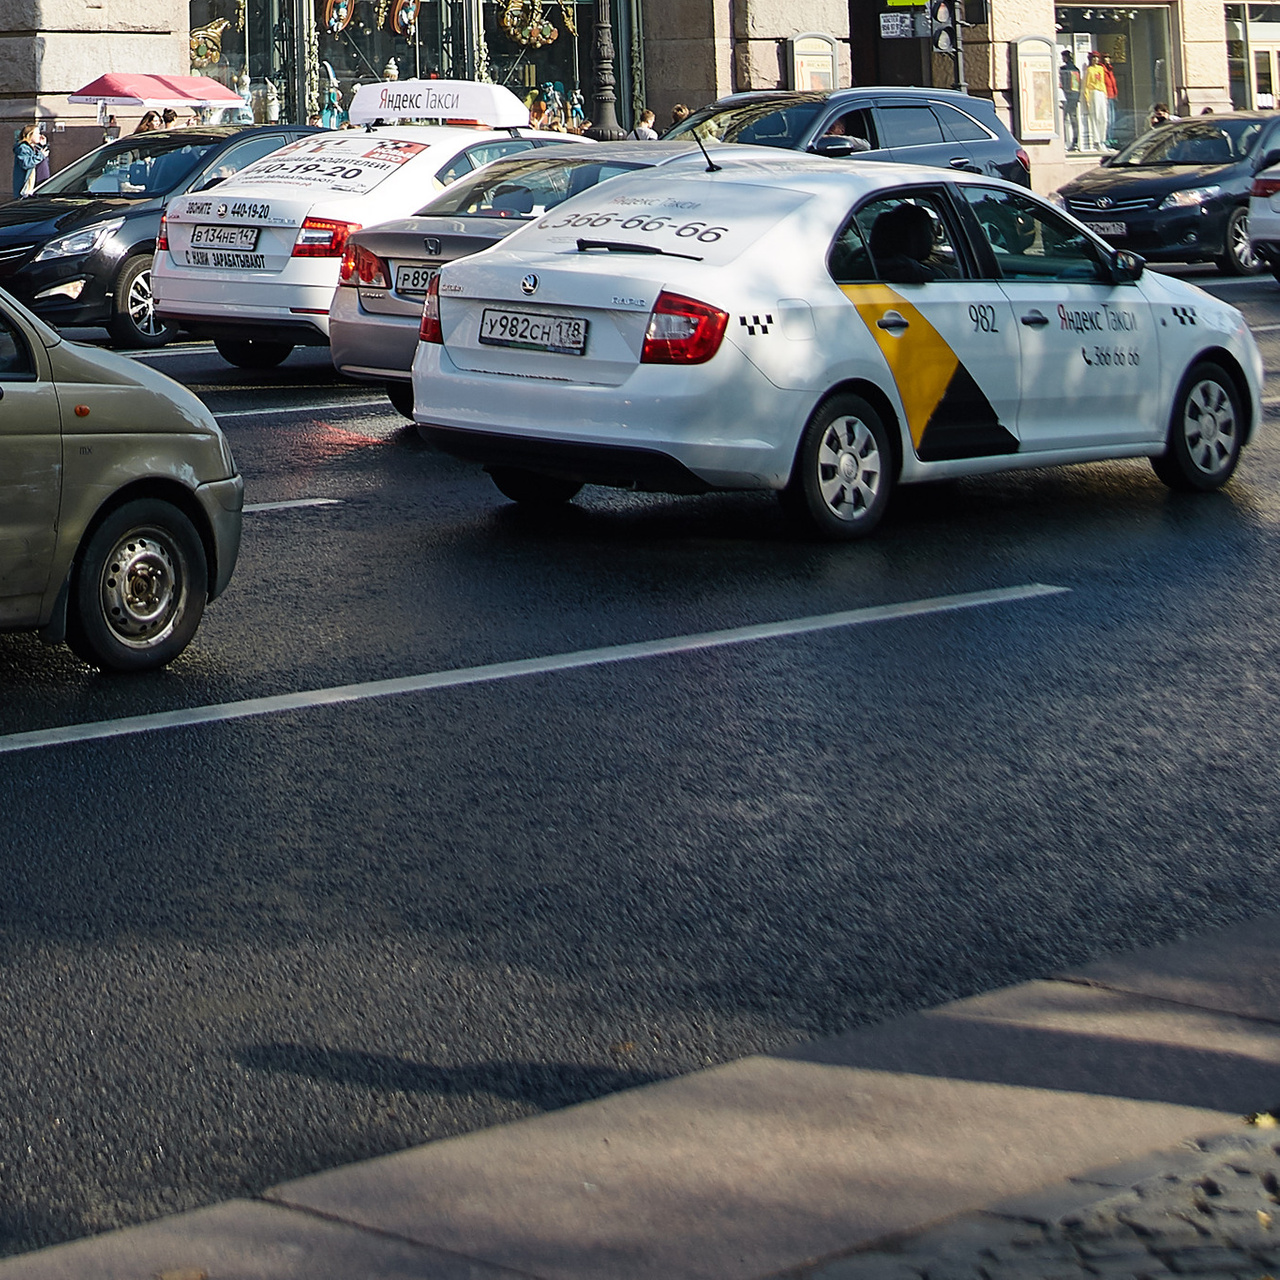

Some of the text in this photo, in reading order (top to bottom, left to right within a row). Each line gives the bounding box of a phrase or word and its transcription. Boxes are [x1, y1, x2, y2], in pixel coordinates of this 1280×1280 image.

[378, 88, 460, 111] Яндекс Такси
[369, 153, 403, 162] АВТО
[186, 202, 212, 215] ЗВОНИТЕ
[231, 202, 270, 219] 440-19-20
[609, 195, 701, 210] Яндекс Такси
[195, 228, 256, 244] В134НЕ 147
[552, 212, 730, 243] 366-66-66
[185, 250, 190, 264] С
[212, 252, 265, 268] ЗАРАБАТЫВАЮТ
[969, 304, 999, 333] 982
[1057, 303, 1138, 334] Яндекс Такси
[489, 315, 552, 341] У982СН
